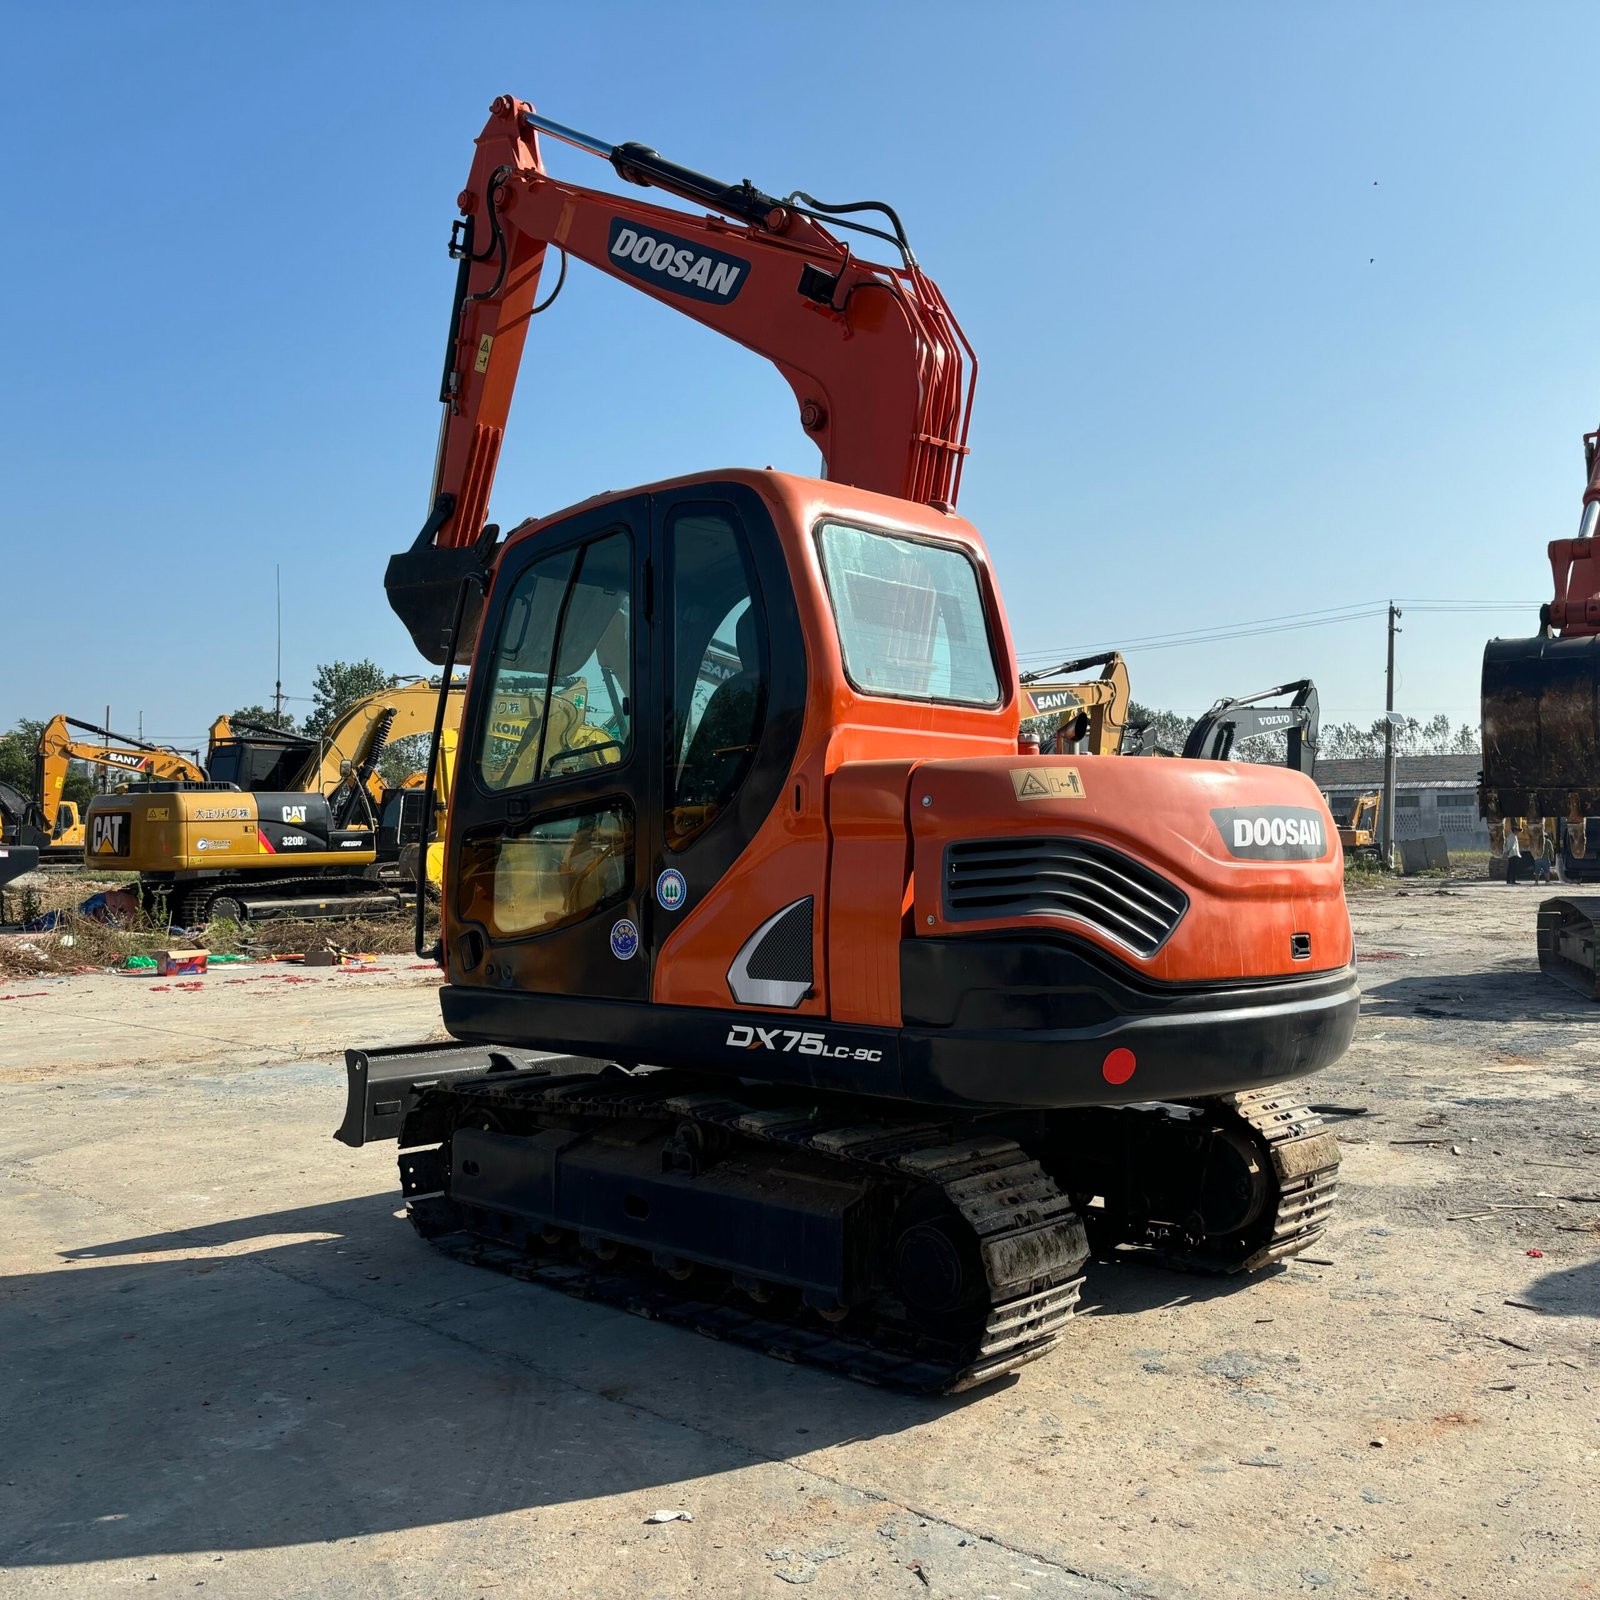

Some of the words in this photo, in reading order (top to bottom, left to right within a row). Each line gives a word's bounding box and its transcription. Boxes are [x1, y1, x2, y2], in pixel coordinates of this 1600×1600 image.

[611, 228, 741, 296] DOOSAN
[1037, 692, 1068, 710] SANY
[1258, 715, 1290, 726] VOLVO
[109, 753, 138, 766] SANY
[282, 805, 307, 823] CAT
[92, 815, 123, 853] CAT
[1233, 817, 1321, 847] DOOSAN
